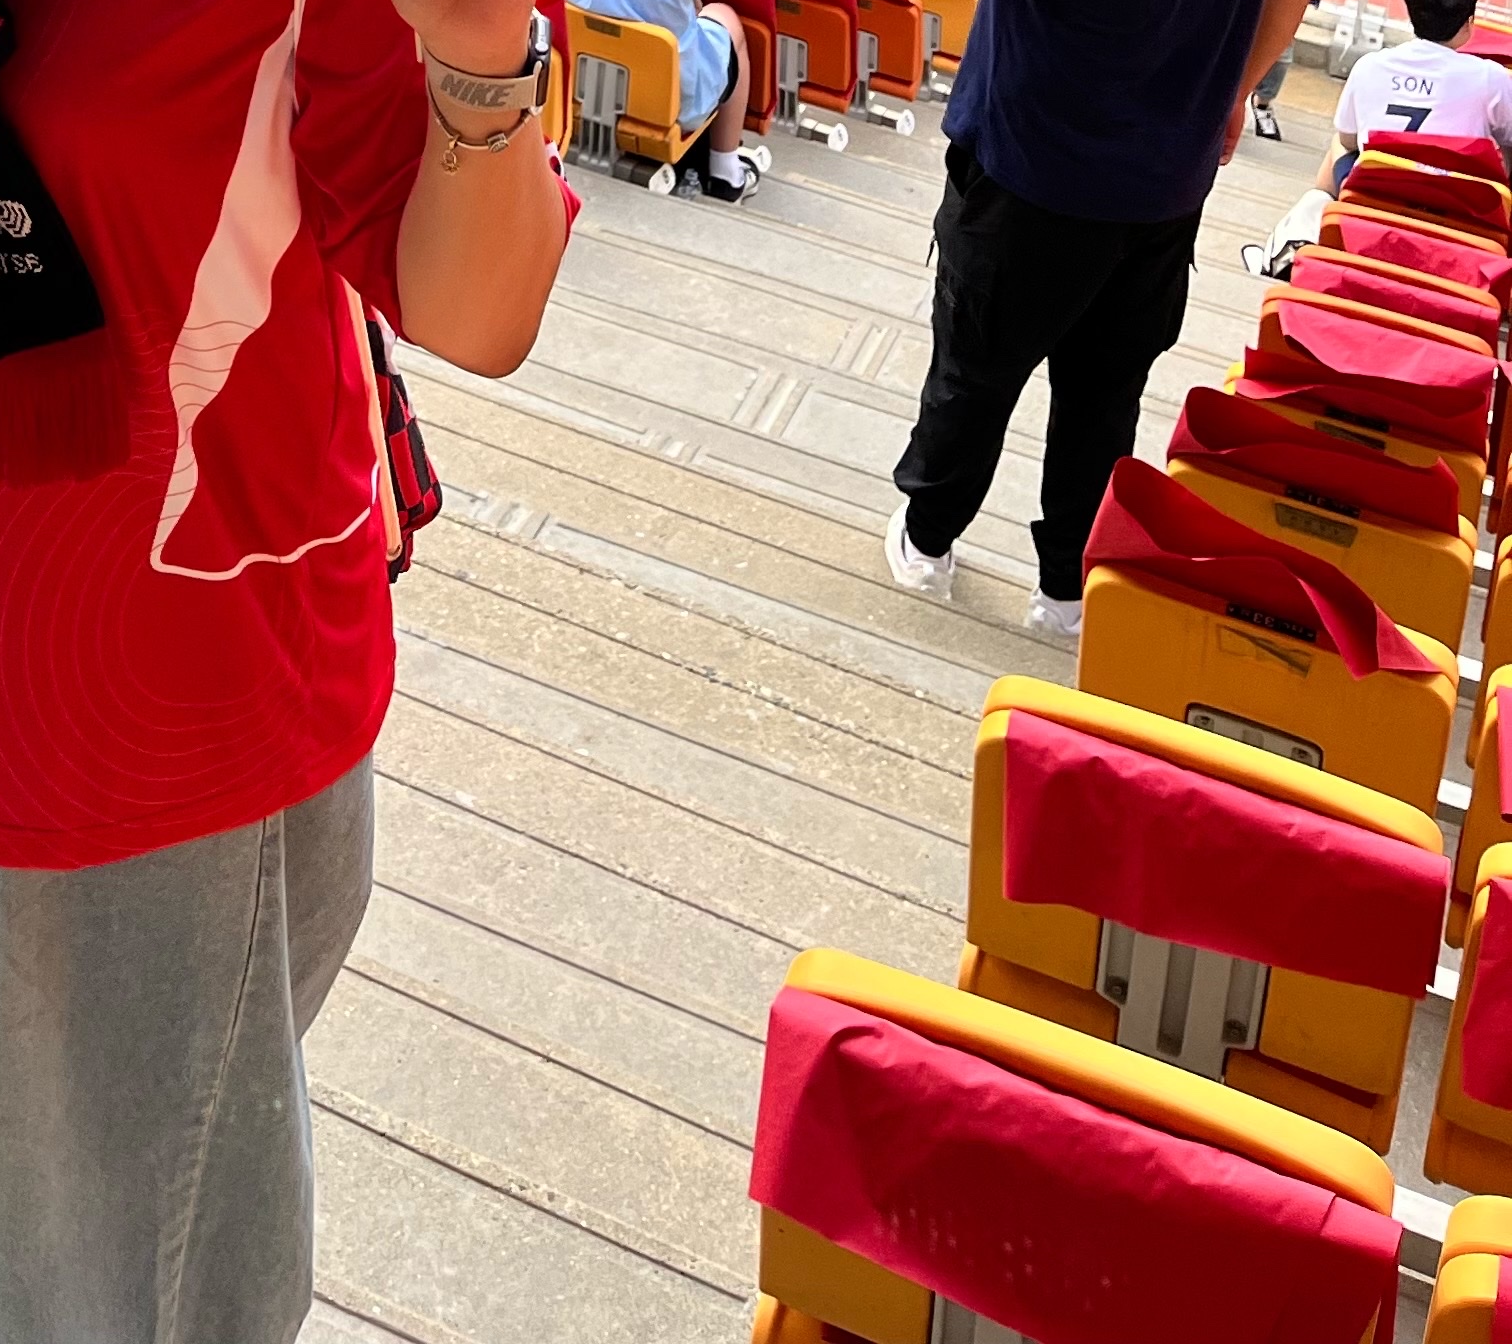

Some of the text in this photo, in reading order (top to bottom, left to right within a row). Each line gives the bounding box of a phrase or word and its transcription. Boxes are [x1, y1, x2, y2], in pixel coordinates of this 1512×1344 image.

[440, 73, 516, 107] NIKE
[1391, 75, 1434, 96] SON
[1385, 103, 1433, 132] 7
